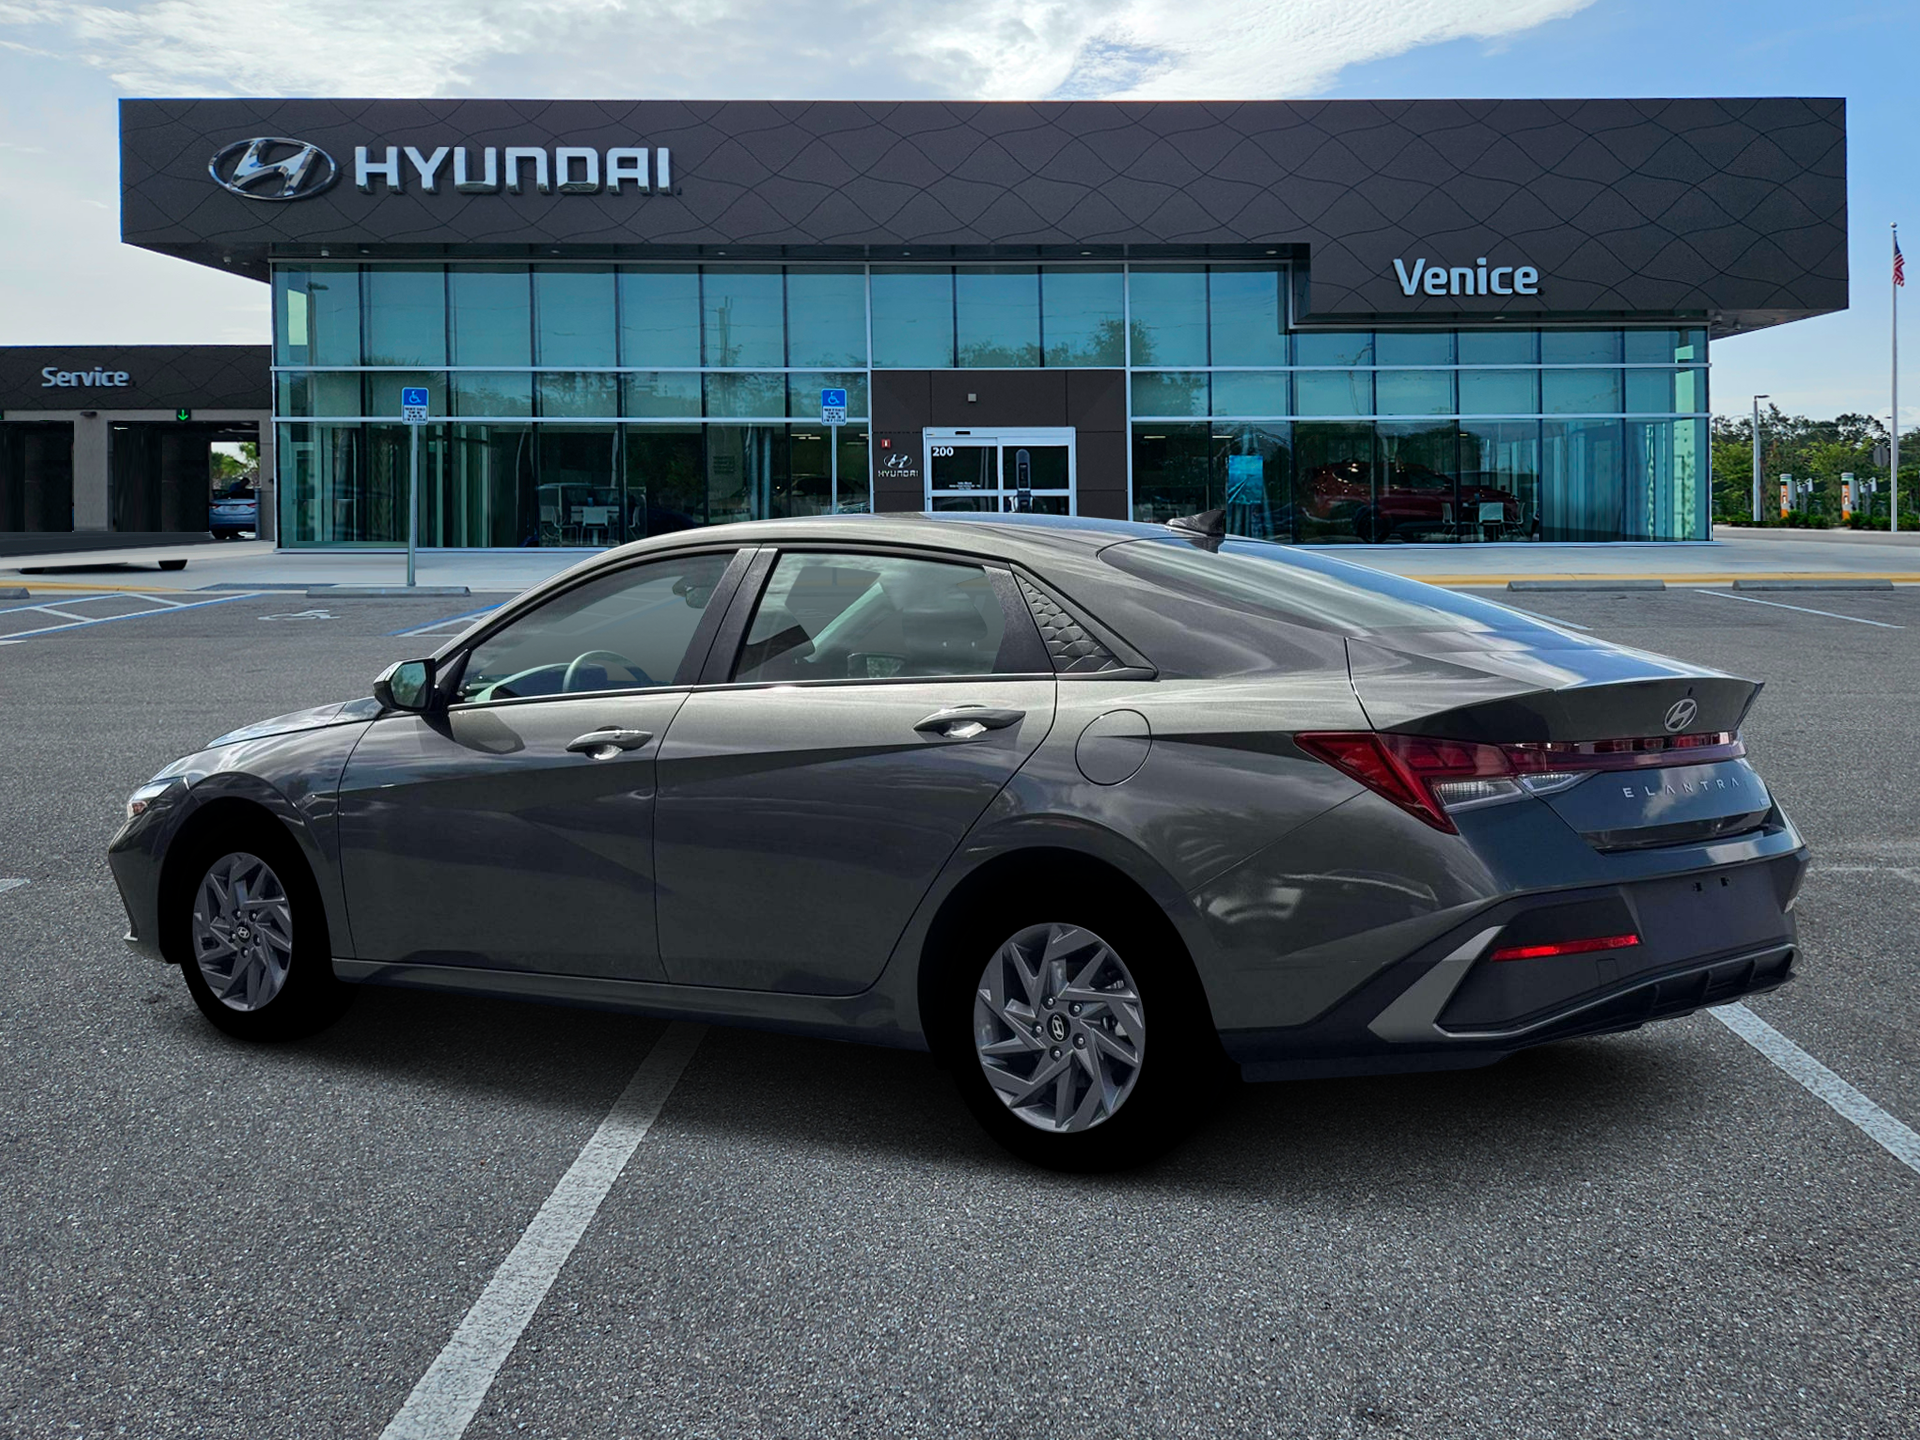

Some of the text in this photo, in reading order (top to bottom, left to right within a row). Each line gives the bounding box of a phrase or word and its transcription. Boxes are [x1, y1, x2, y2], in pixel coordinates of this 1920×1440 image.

[354, 146, 671, 194] HYUNDAI
[1393, 257, 1539, 296] Venice
[41, 366, 130, 387] Service
[932, 447, 954, 457] 200
[1622, 777, 1740, 798] ELANTRA
